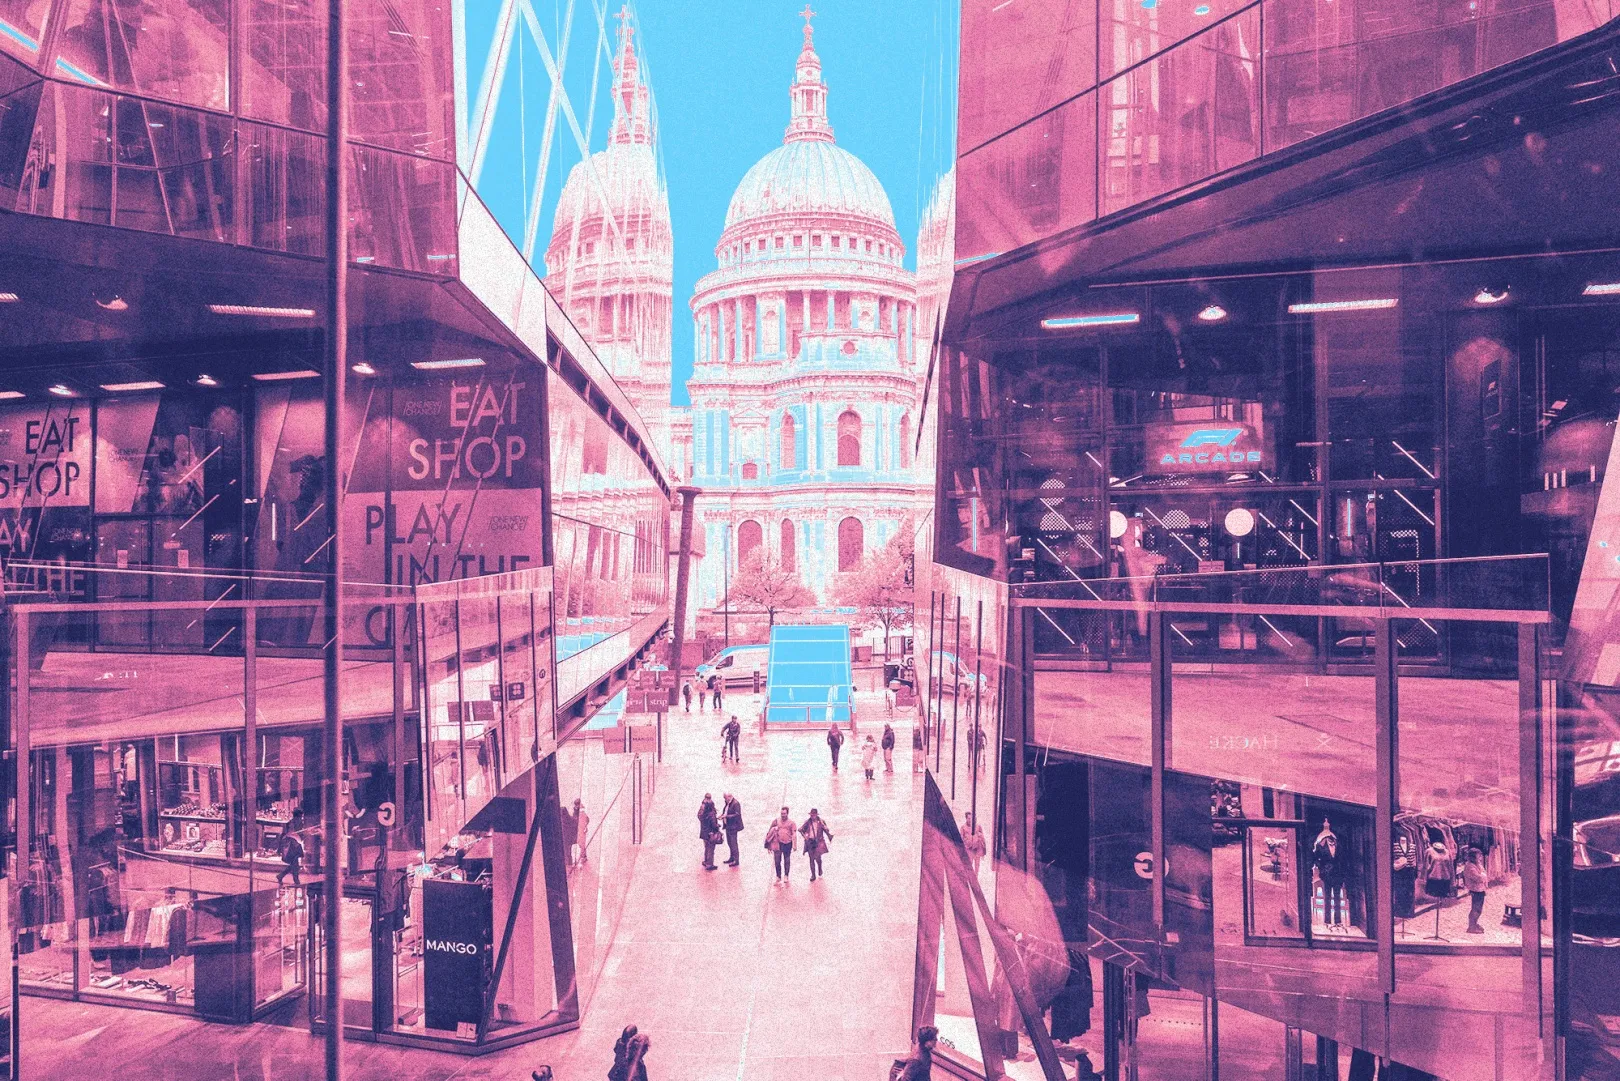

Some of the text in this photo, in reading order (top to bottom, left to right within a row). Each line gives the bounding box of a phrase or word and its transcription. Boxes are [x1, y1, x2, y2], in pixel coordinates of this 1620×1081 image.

[450, 382, 526, 428] EAT
[26, 418, 80, 454] EAT
[407, 436, 527, 480] SHOP
[1160, 451, 1261, 464] ARCADE
[366, 502, 462, 546] PLAY
[426, 939, 477, 955] MANGO
